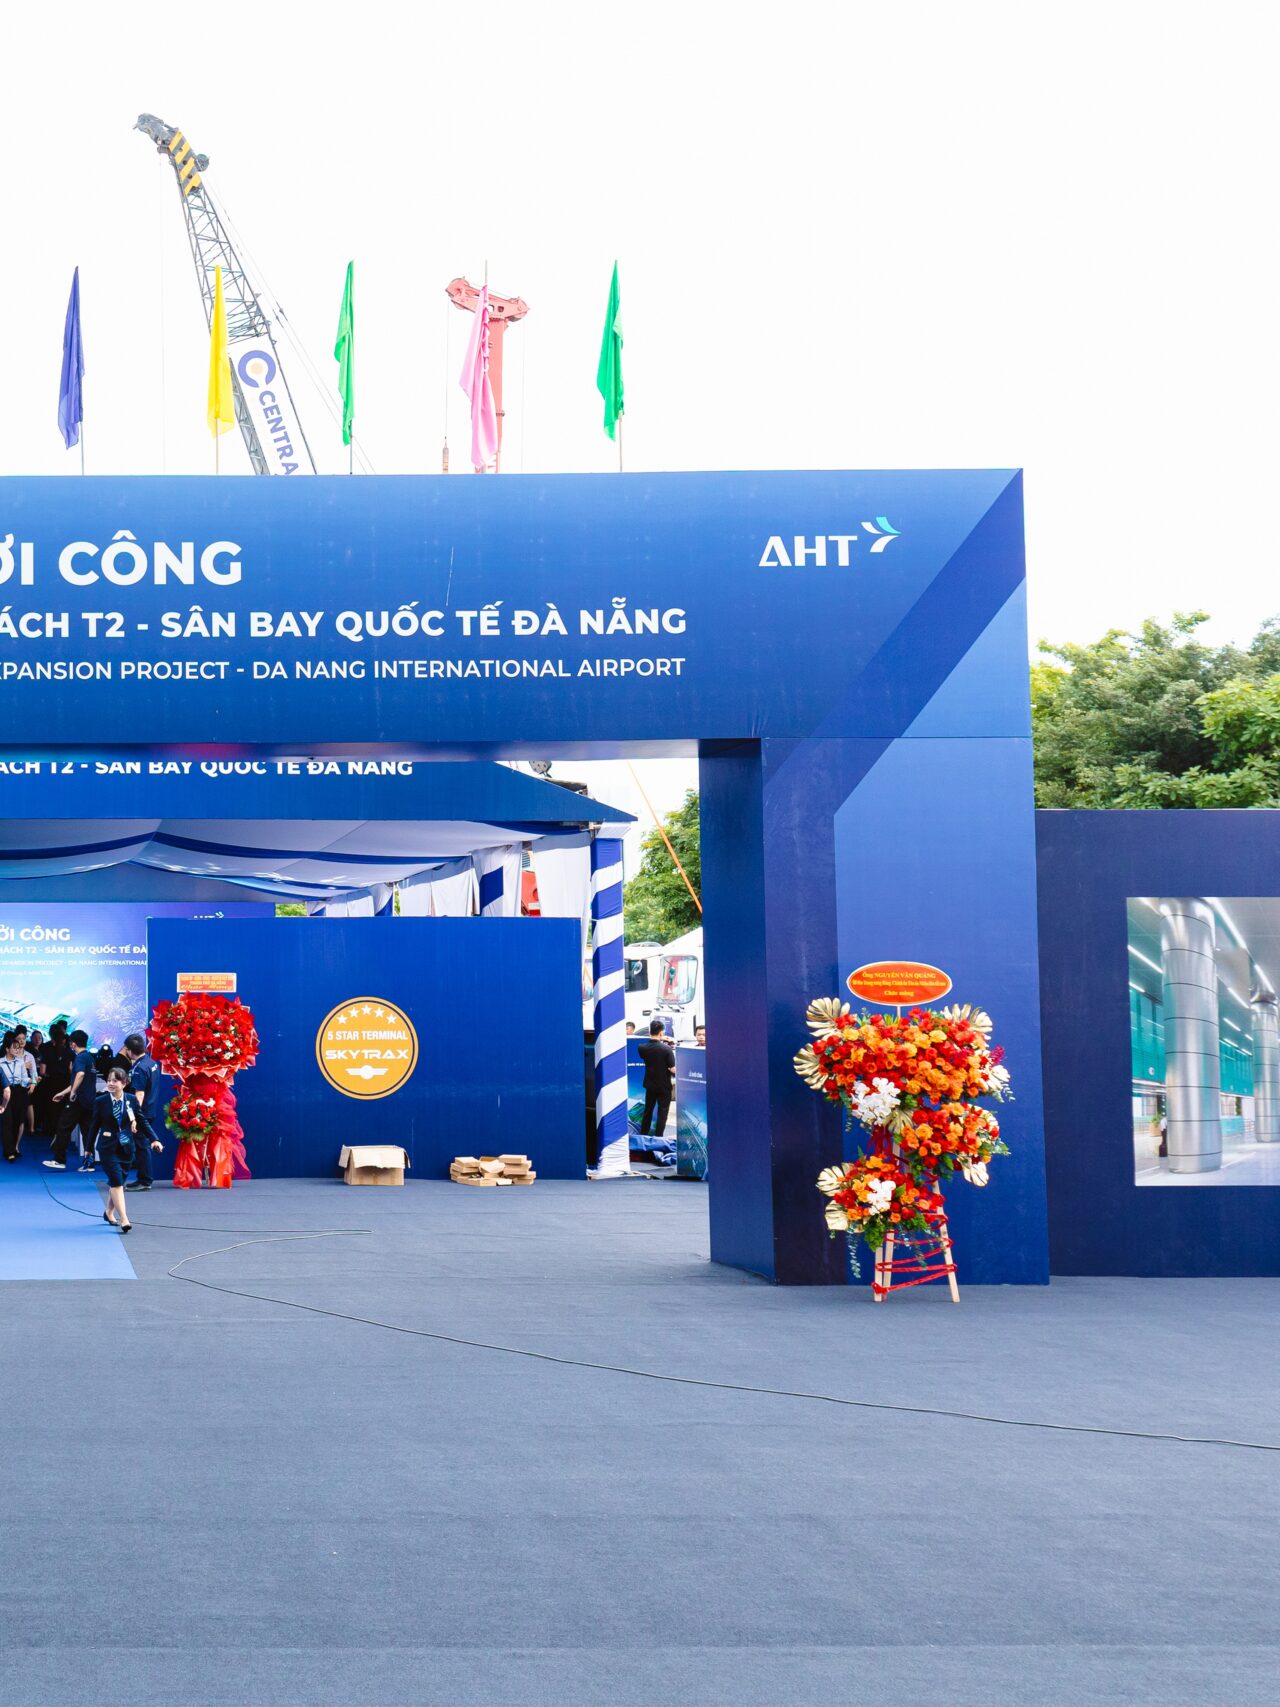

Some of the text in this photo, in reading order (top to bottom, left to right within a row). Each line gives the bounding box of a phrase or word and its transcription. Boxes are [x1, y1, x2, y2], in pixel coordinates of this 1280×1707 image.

[58, 529, 242, 586] CÔNG
[758, 535, 858, 567] AHT
[81, 611, 125, 638] T2
[161, 605, 236, 638] SÂN
[250, 611, 324, 637] BAY
[335, 601, 445, 642] QUỐC
[455, 600, 503, 636] TẾ
[511, 603, 568, 636] ĐÀ
[579, 598, 687, 635] NẴNG
[121, 661, 230, 680] PROJECT
[253, 661, 288, 679] DA
[295, 660, 365, 679] NANG
[374, 659, 571, 678] INTERNATIONAL
[577, 657, 687, 677] AIRPORT
[19, 924, 71, 942] CÔNG
[25, 945, 37, 954] T2
[67, 945, 87, 954] BAY
[88, 943, 117, 955] QUỐC
[118, 943, 131, 954] TẾ
[327, 1030, 409, 1040] 5 STAR TERMINAL
[325, 1049, 409, 1060] SKYTRAX
